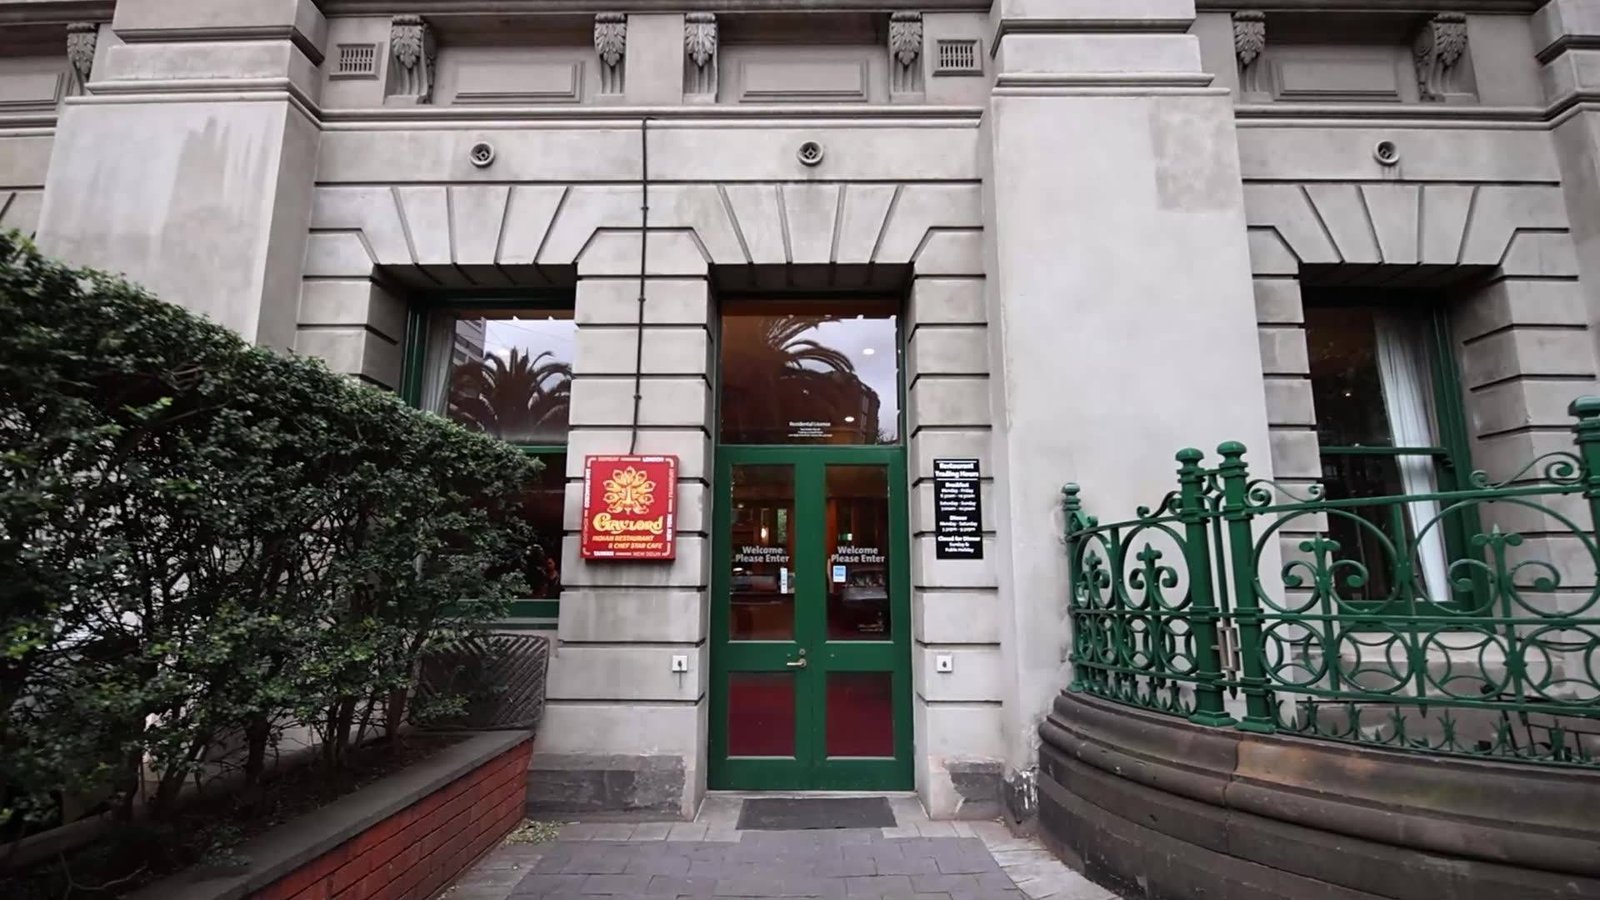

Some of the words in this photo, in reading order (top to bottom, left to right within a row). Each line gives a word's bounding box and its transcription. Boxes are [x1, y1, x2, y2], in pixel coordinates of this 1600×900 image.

[935, 470, 960, 479] Trading
[742, 546, 784, 554] Welcome
[837, 546, 878, 554] Welcome
[735, 554, 764, 563] Please
[765, 554, 790, 563] Enter
[831, 554, 859, 563] Please
[861, 554, 885, 563] Enter
